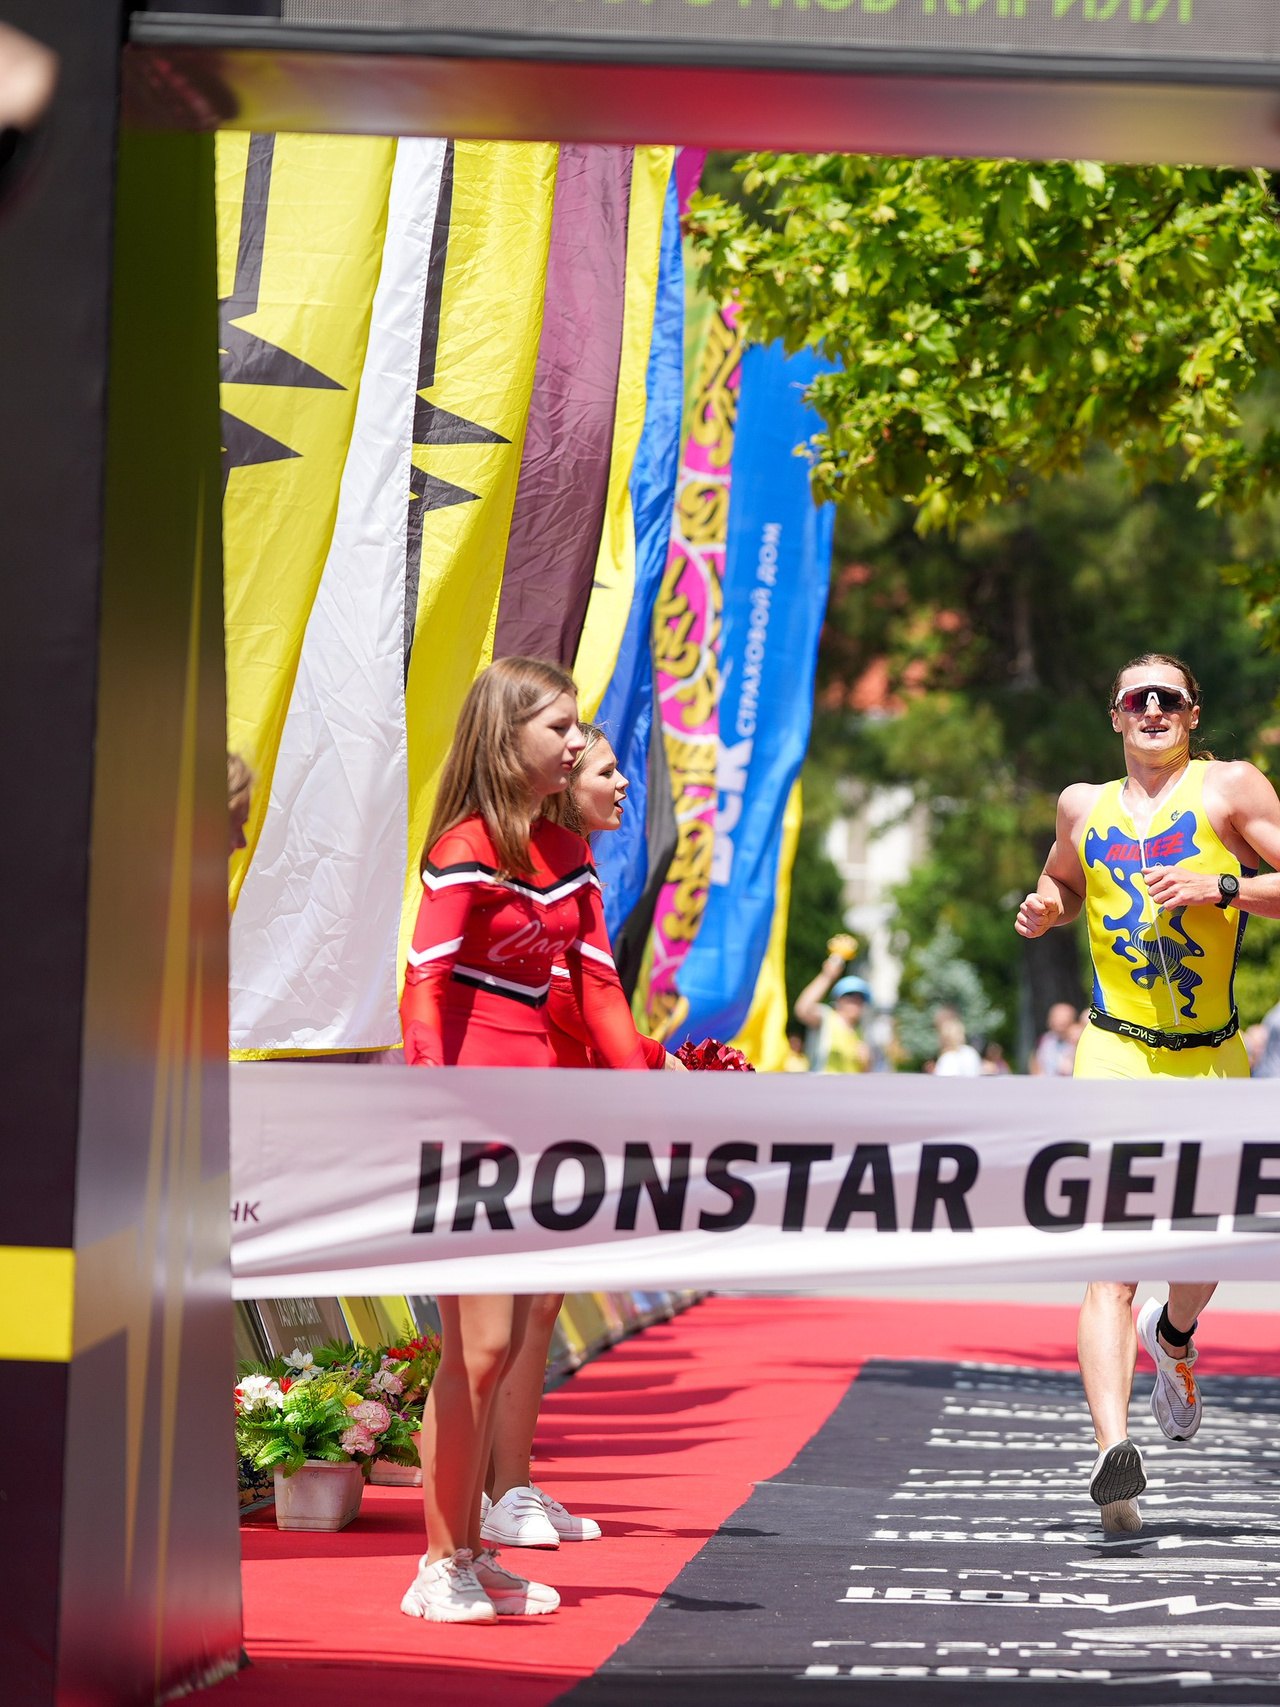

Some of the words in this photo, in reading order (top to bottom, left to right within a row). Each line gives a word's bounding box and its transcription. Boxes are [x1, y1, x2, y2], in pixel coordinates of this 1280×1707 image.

[736, 587, 772, 737] СТРАХОВОЙ
[756, 522, 782, 587] ДОМ
[410, 1139, 981, 1235] IRONSTAR
[872, 1530, 1106, 1542] IRON
[845, 1586, 1110, 1604] IRON
[805, 1663, 1111, 1680] IRON
